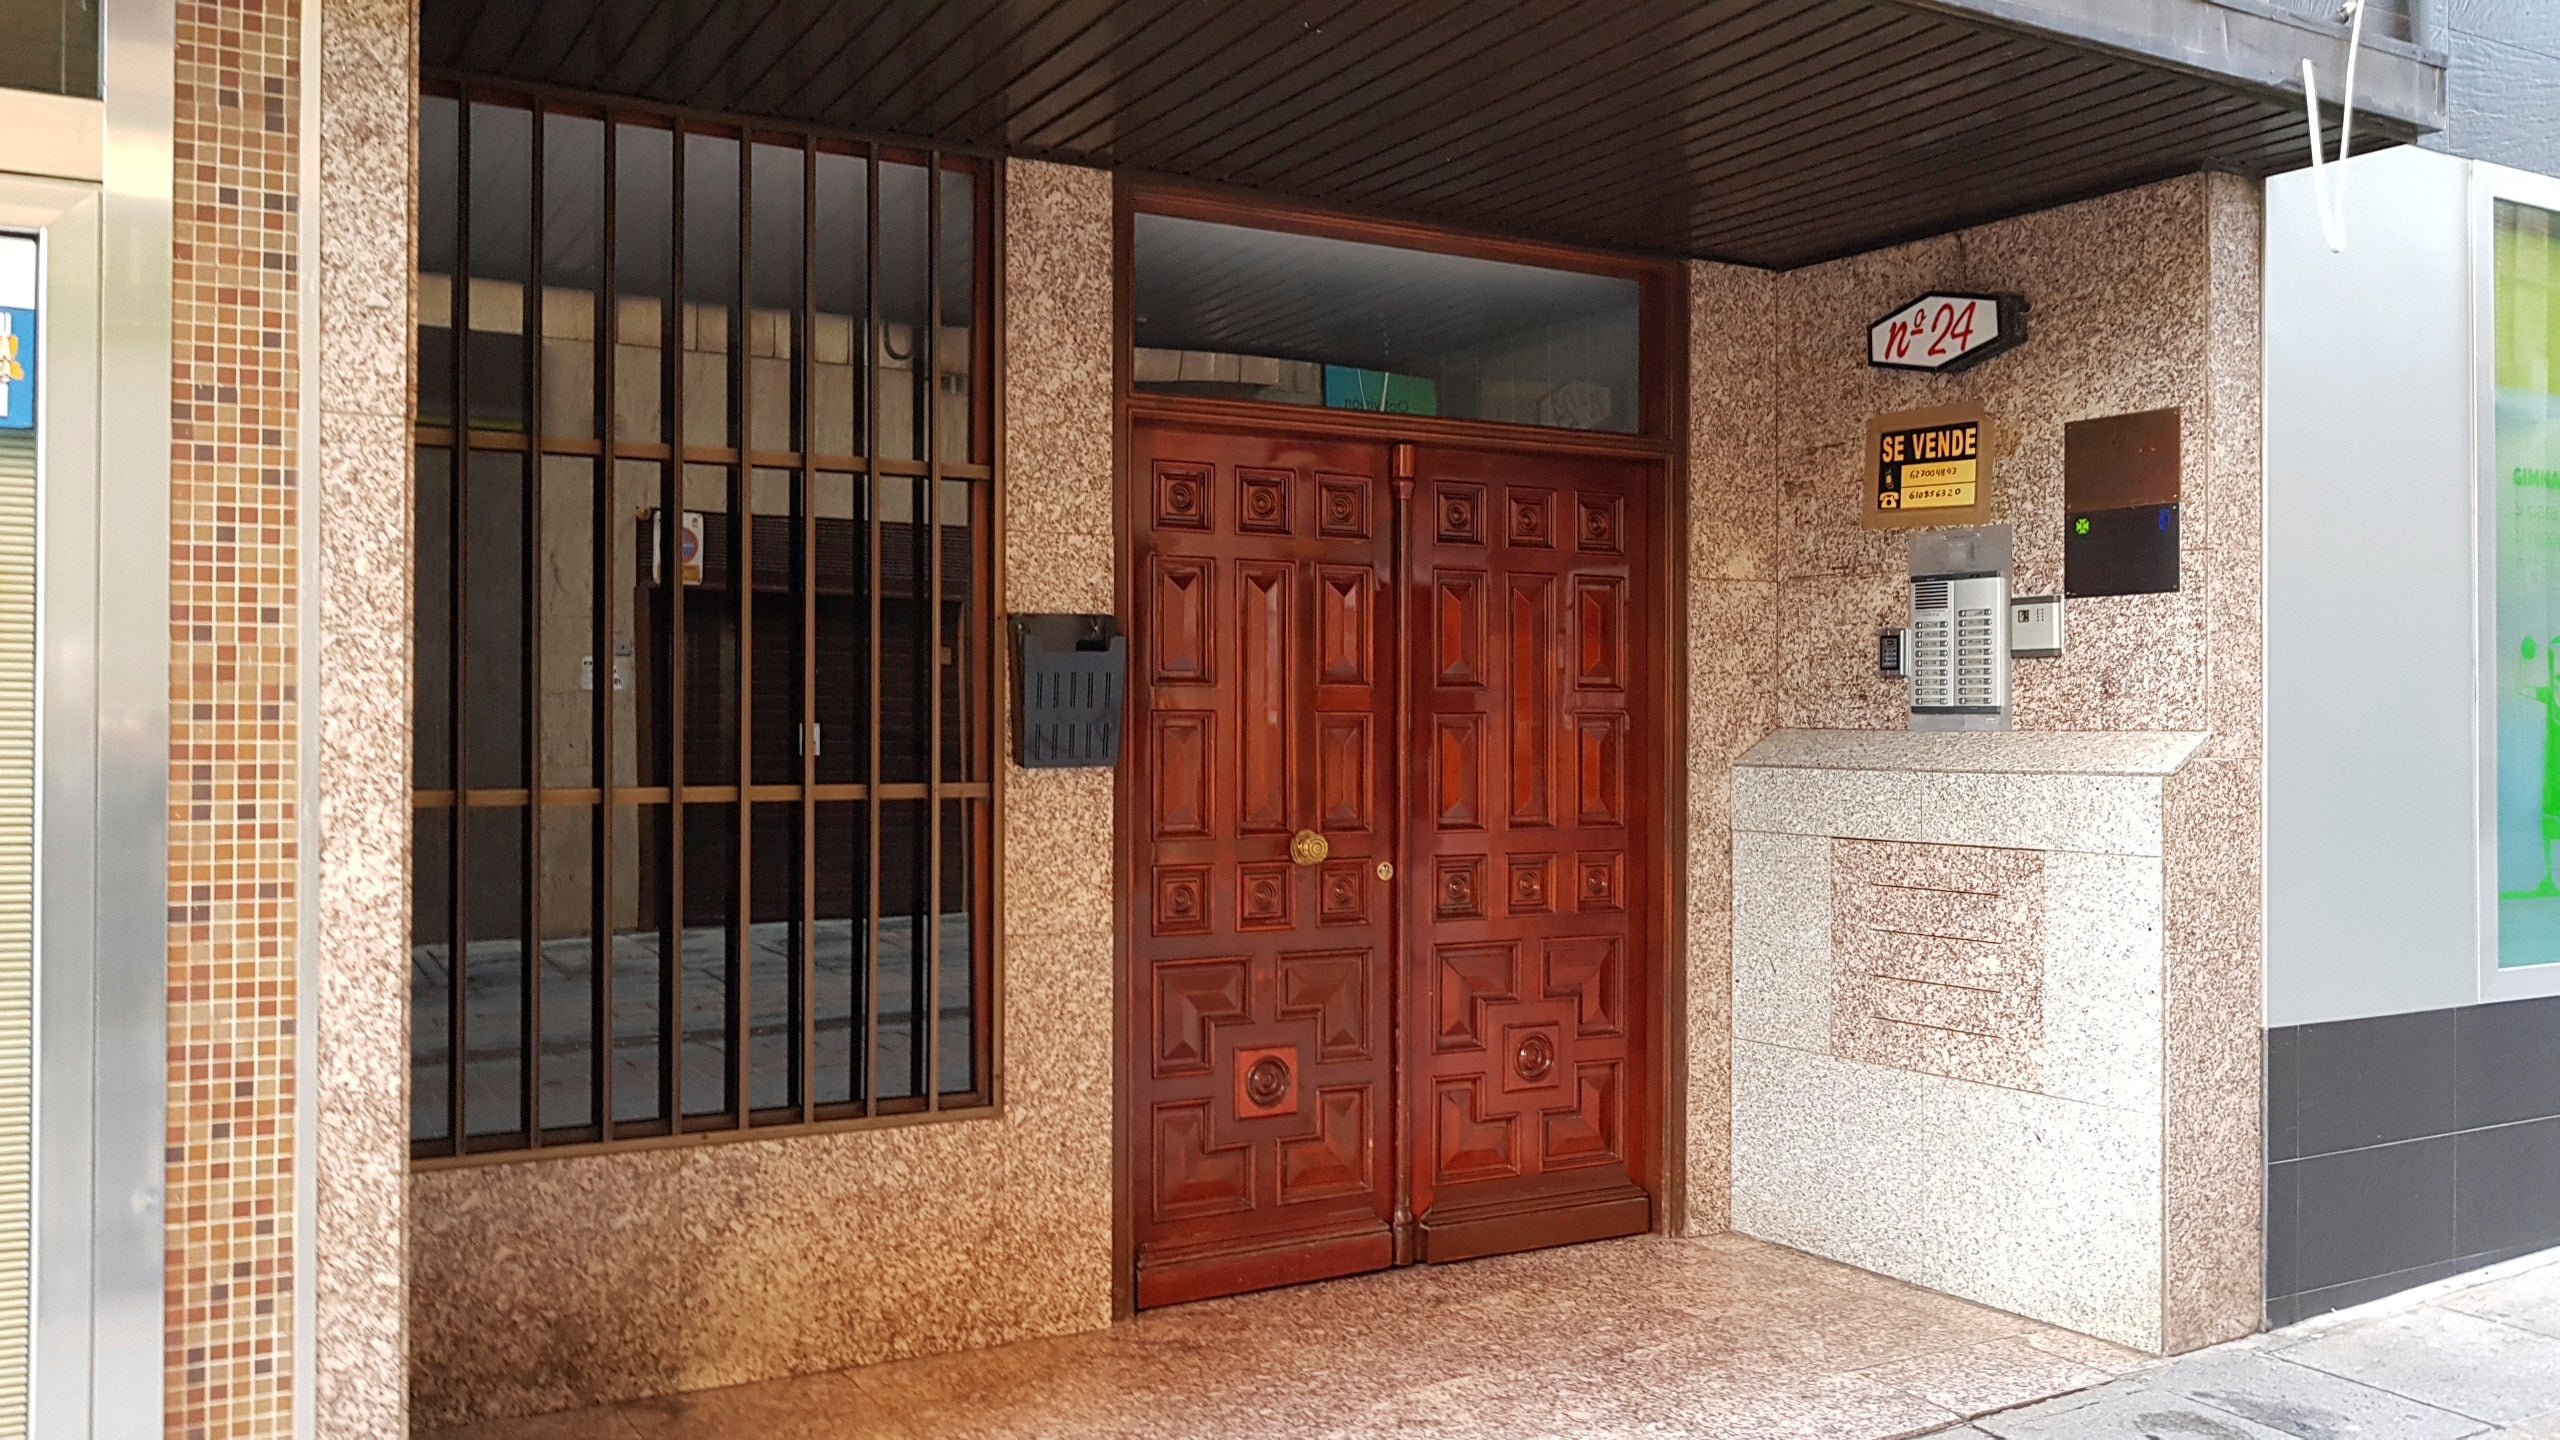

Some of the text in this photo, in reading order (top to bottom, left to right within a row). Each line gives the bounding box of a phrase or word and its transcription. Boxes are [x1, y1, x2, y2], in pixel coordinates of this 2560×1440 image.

[1928, 301, 1976, 357] 24
[1882, 427, 1977, 463] SE VENDE
